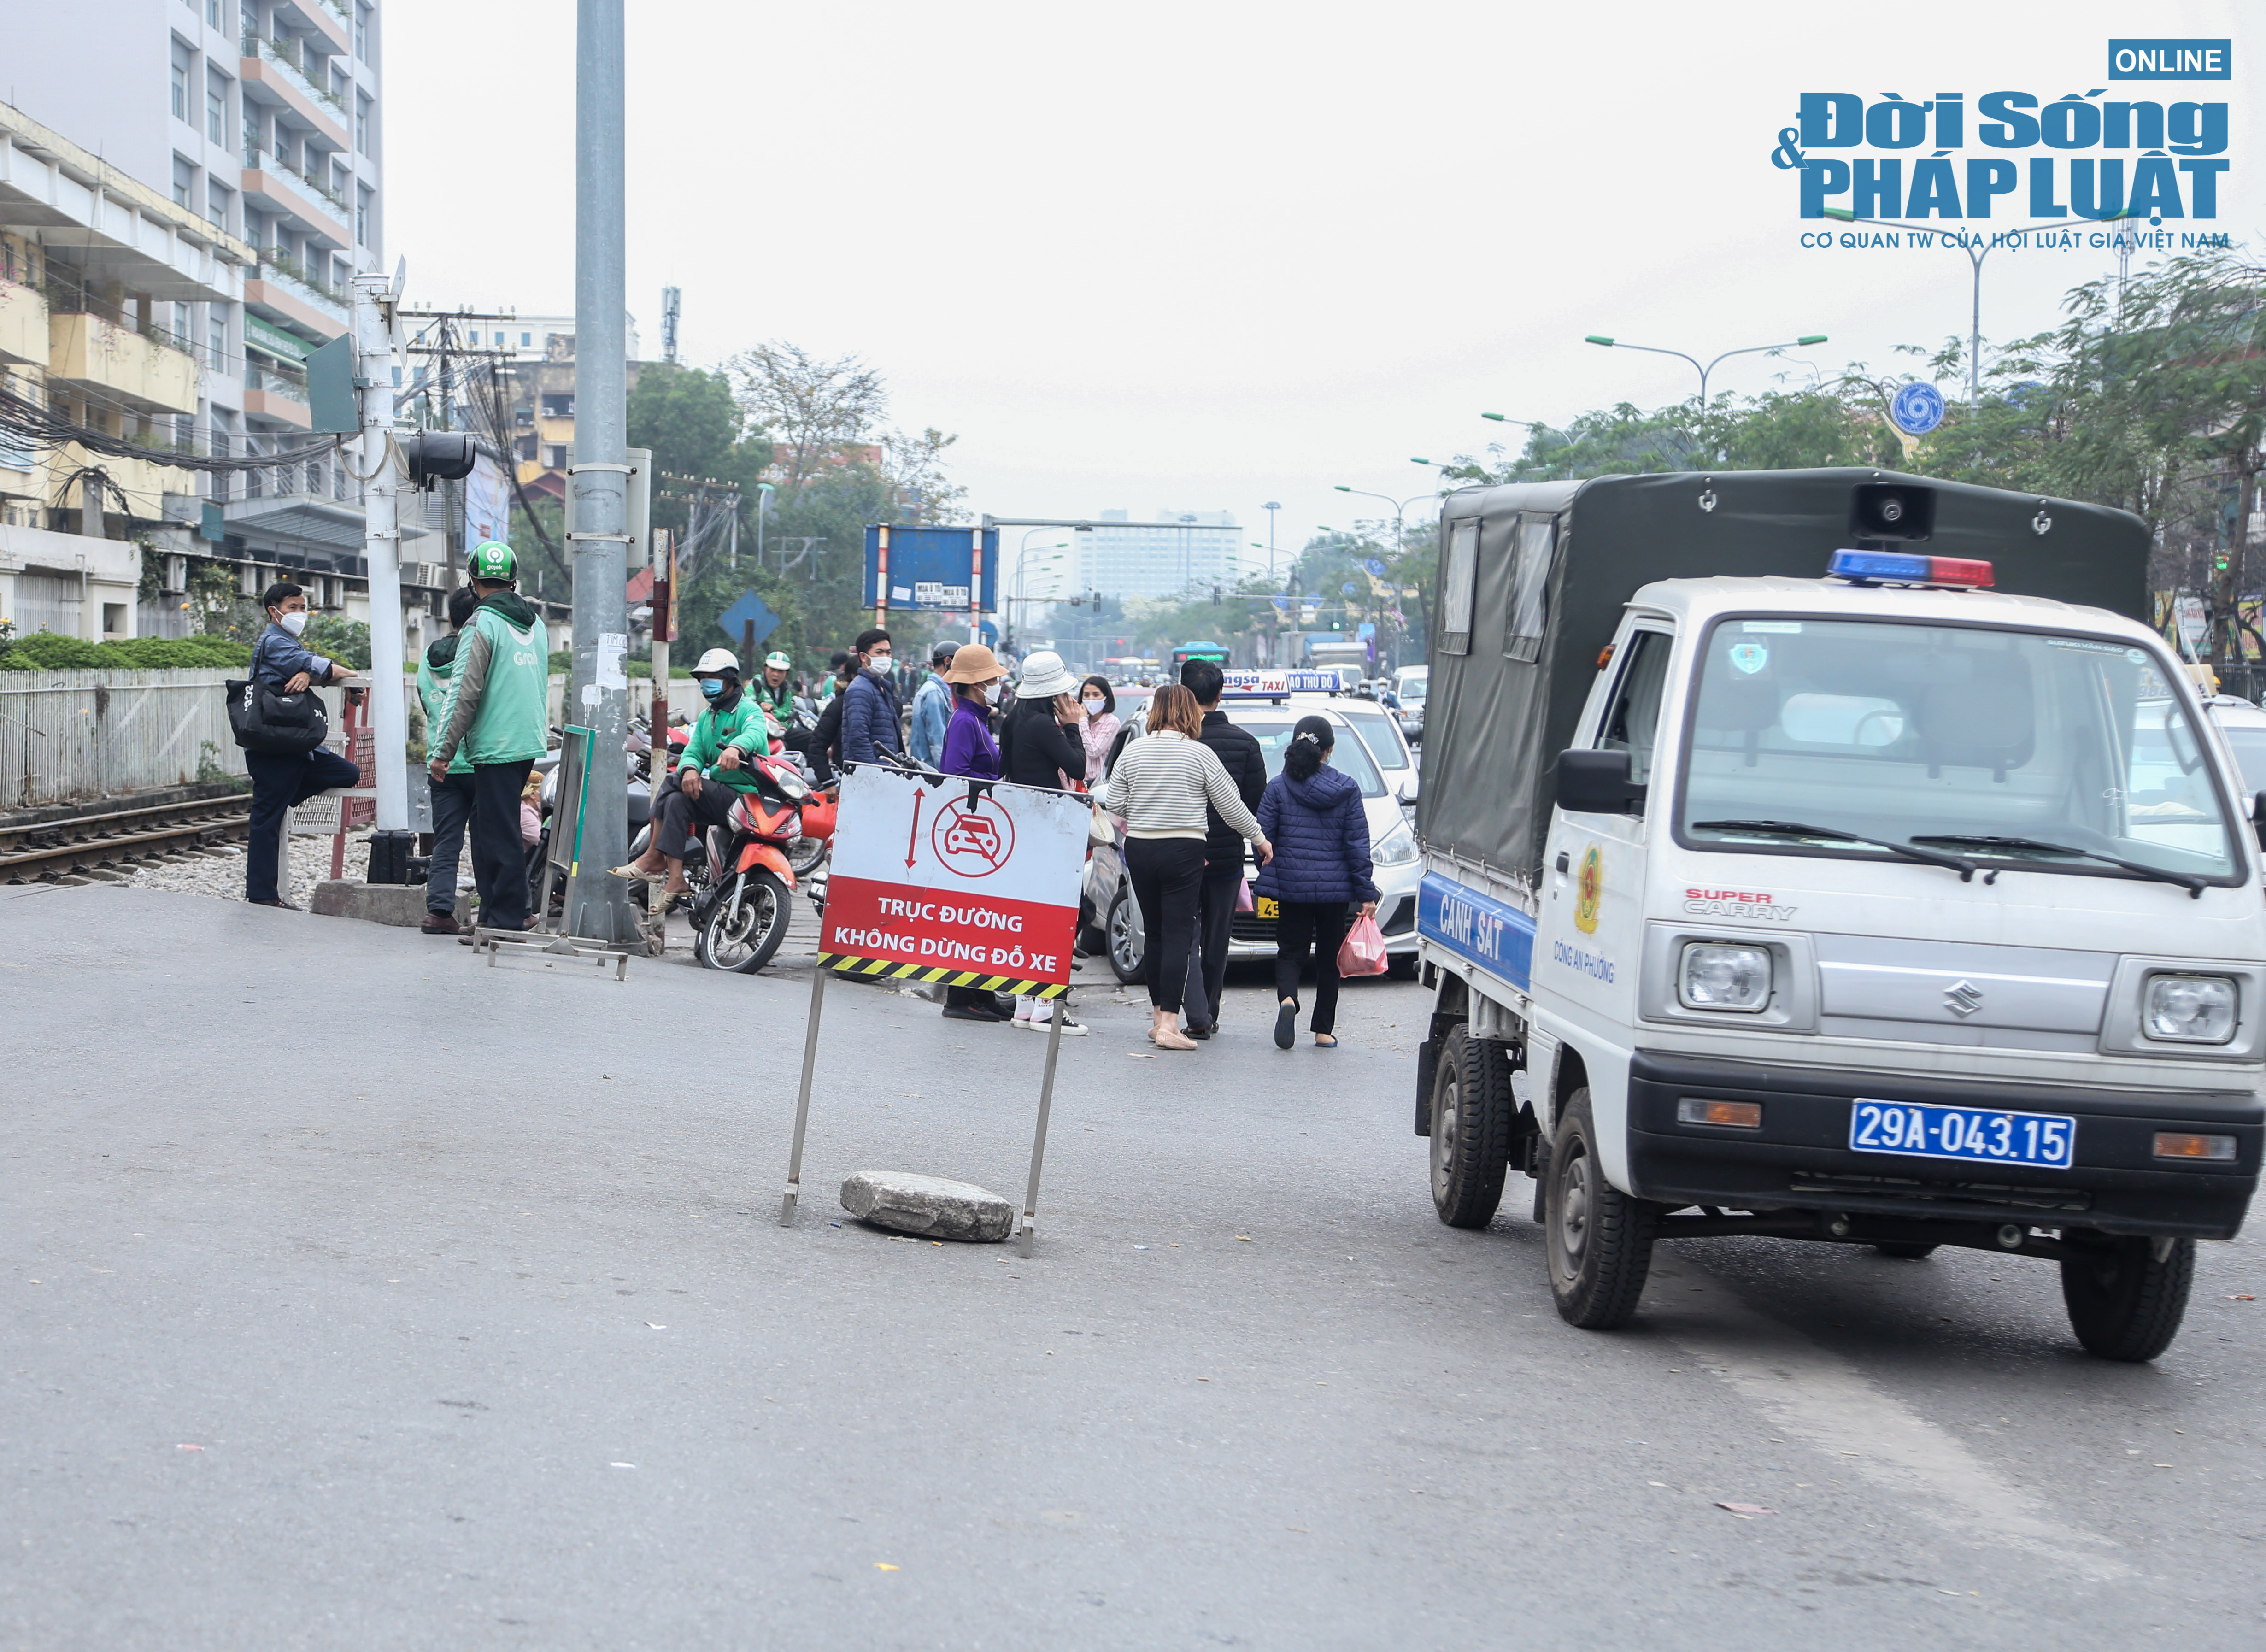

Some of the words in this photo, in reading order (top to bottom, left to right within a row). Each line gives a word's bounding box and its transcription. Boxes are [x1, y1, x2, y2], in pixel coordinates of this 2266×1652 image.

[1262, 681, 1285, 691] TAXI
[1303, 673, 1319, 688] THỦ
[1684, 899, 1798, 921] CARRY
[1685, 888, 1773, 904] SUPER
[878, 897, 936, 923] TRỤC
[939, 905, 1023, 933] ĐƯỜNG
[1440, 887, 1473, 946] CẢNH
[1477, 908, 1503, 960] SÁT
[834, 926, 915, 953] KHÔNG
[920, 937, 986, 963] DỪNG
[991, 944, 1025, 968] ĐỖ
[1028, 952, 1057, 973] XE
[1573, 949, 1584, 971] AN
[1585, 950, 1614, 984] PHƯỜNG
[1857, 1105, 2067, 1161] 29A-043.15
